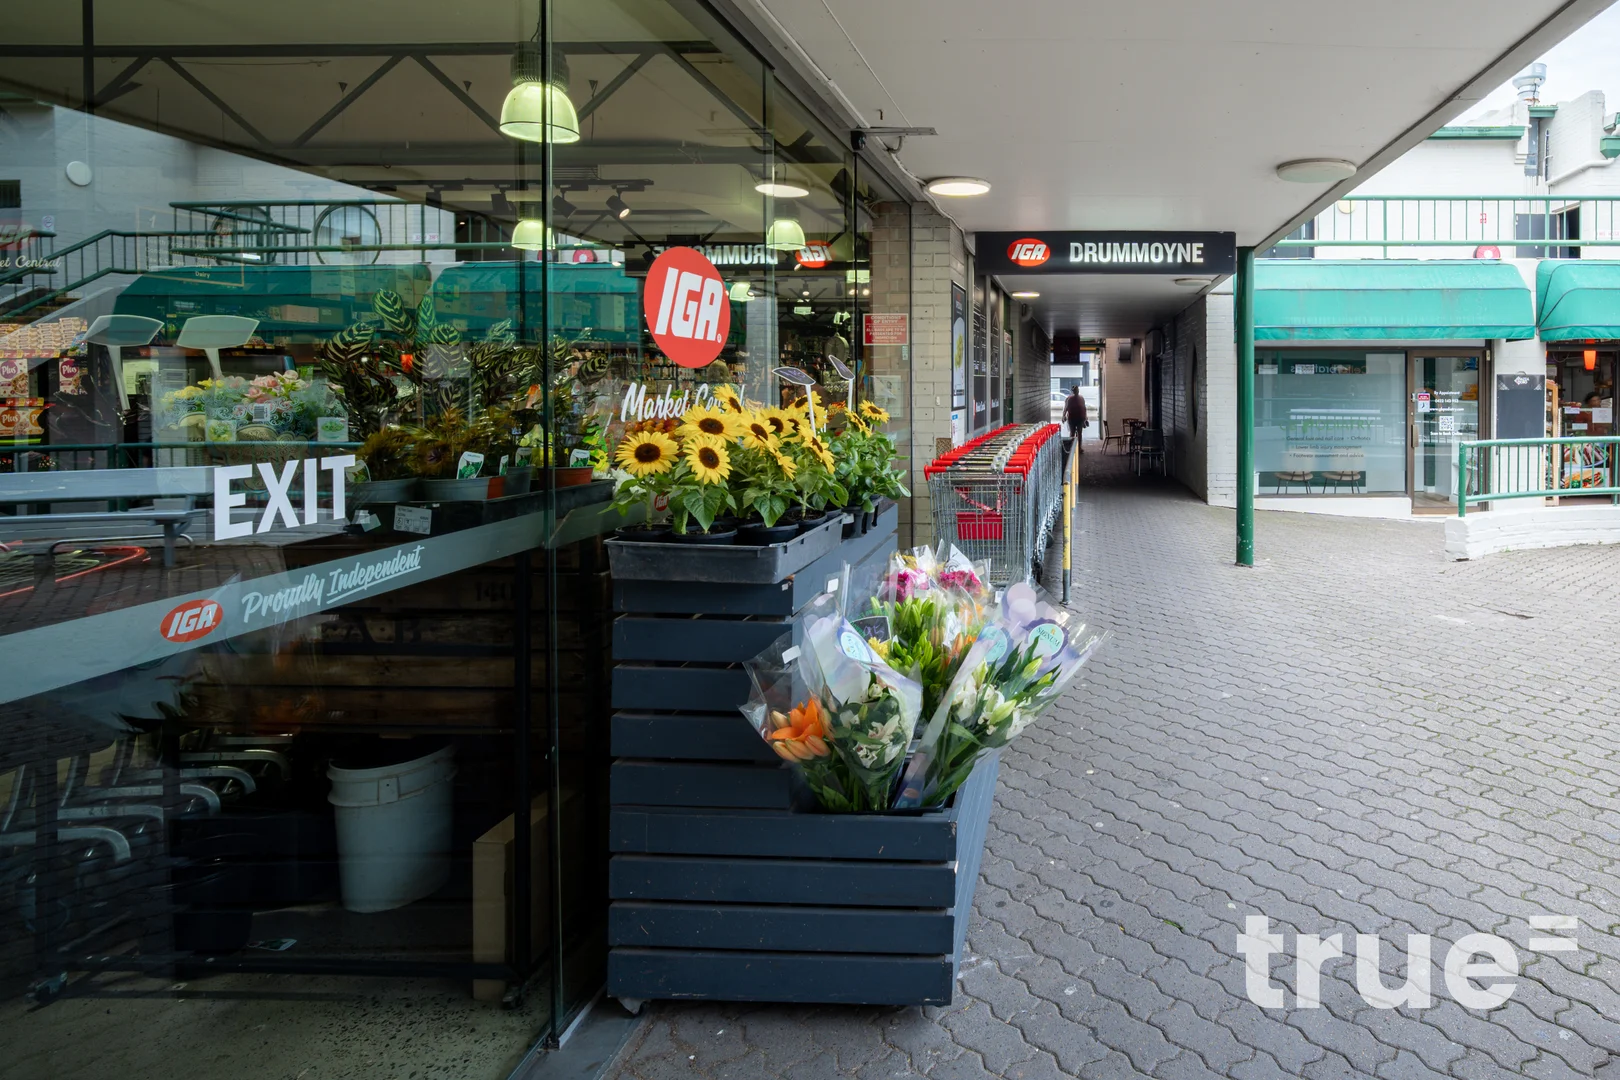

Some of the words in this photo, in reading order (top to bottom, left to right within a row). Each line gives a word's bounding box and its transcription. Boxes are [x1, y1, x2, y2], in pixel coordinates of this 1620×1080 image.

[15, 254, 62, 268] Central
[1011, 242, 1045, 260] IGA
[1069, 242, 1204, 264] DRUMMOYNE
[195, 270, 211, 279] Dairy
[654, 266, 721, 342] IGA
[1, 364, 17, 375] Plus
[61, 364, 78, 375] Plus
[620, 382, 690, 422] Market
[1, 414, 19, 423] Plus
[214, 454, 356, 541] EXIT
[241, 573, 325, 622] Proudly
[326, 545, 425, 597] Independent
[167, 603, 214, 639] IGA
[1036, 627, 1061, 647] SIGNUM
